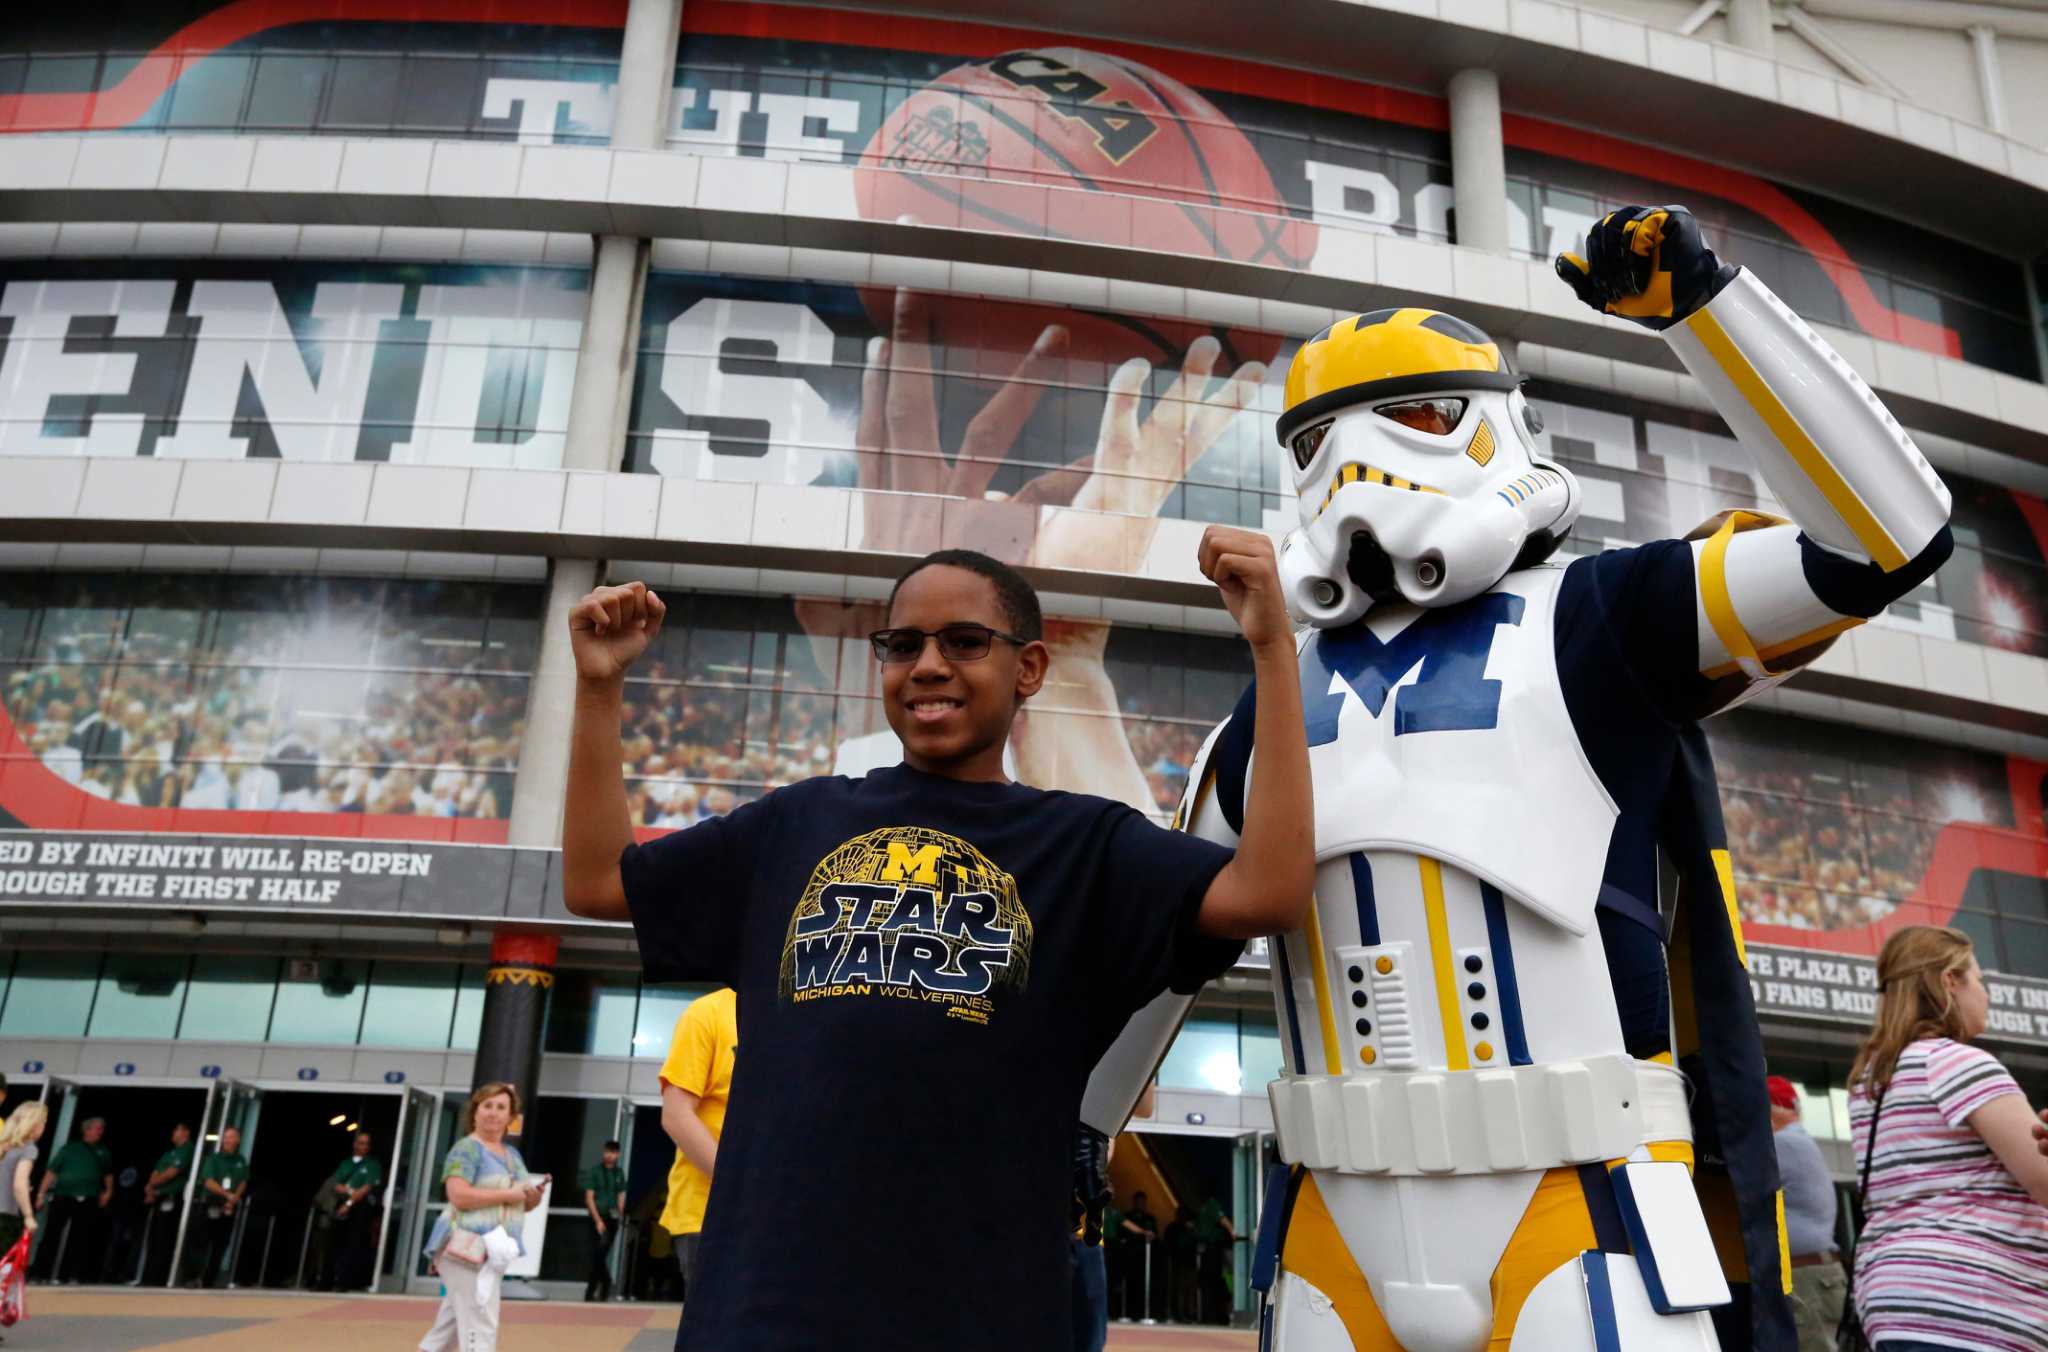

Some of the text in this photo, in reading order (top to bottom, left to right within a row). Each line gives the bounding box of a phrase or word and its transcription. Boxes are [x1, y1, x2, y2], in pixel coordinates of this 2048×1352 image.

[1297, 592, 1526, 747] M
[38, 842, 83, 865] BY
[86, 843, 215, 869] INFINITI
[221, 846, 294, 871] WILL
[300, 849, 432, 876] RE-OPEN
[880, 842, 943, 884] M
[0, 870, 341, 902] OUGH THE FIRST HALF
[796, 883, 1013, 946] STAR
[794, 932, 1011, 994] WARS
[1777, 956, 1852, 985] PLAZA
[1988, 983, 2017, 1007] BY
[793, 984, 992, 1012] MICHIGAN WOLVERINES
[1764, 981, 1826, 1009] FANS
